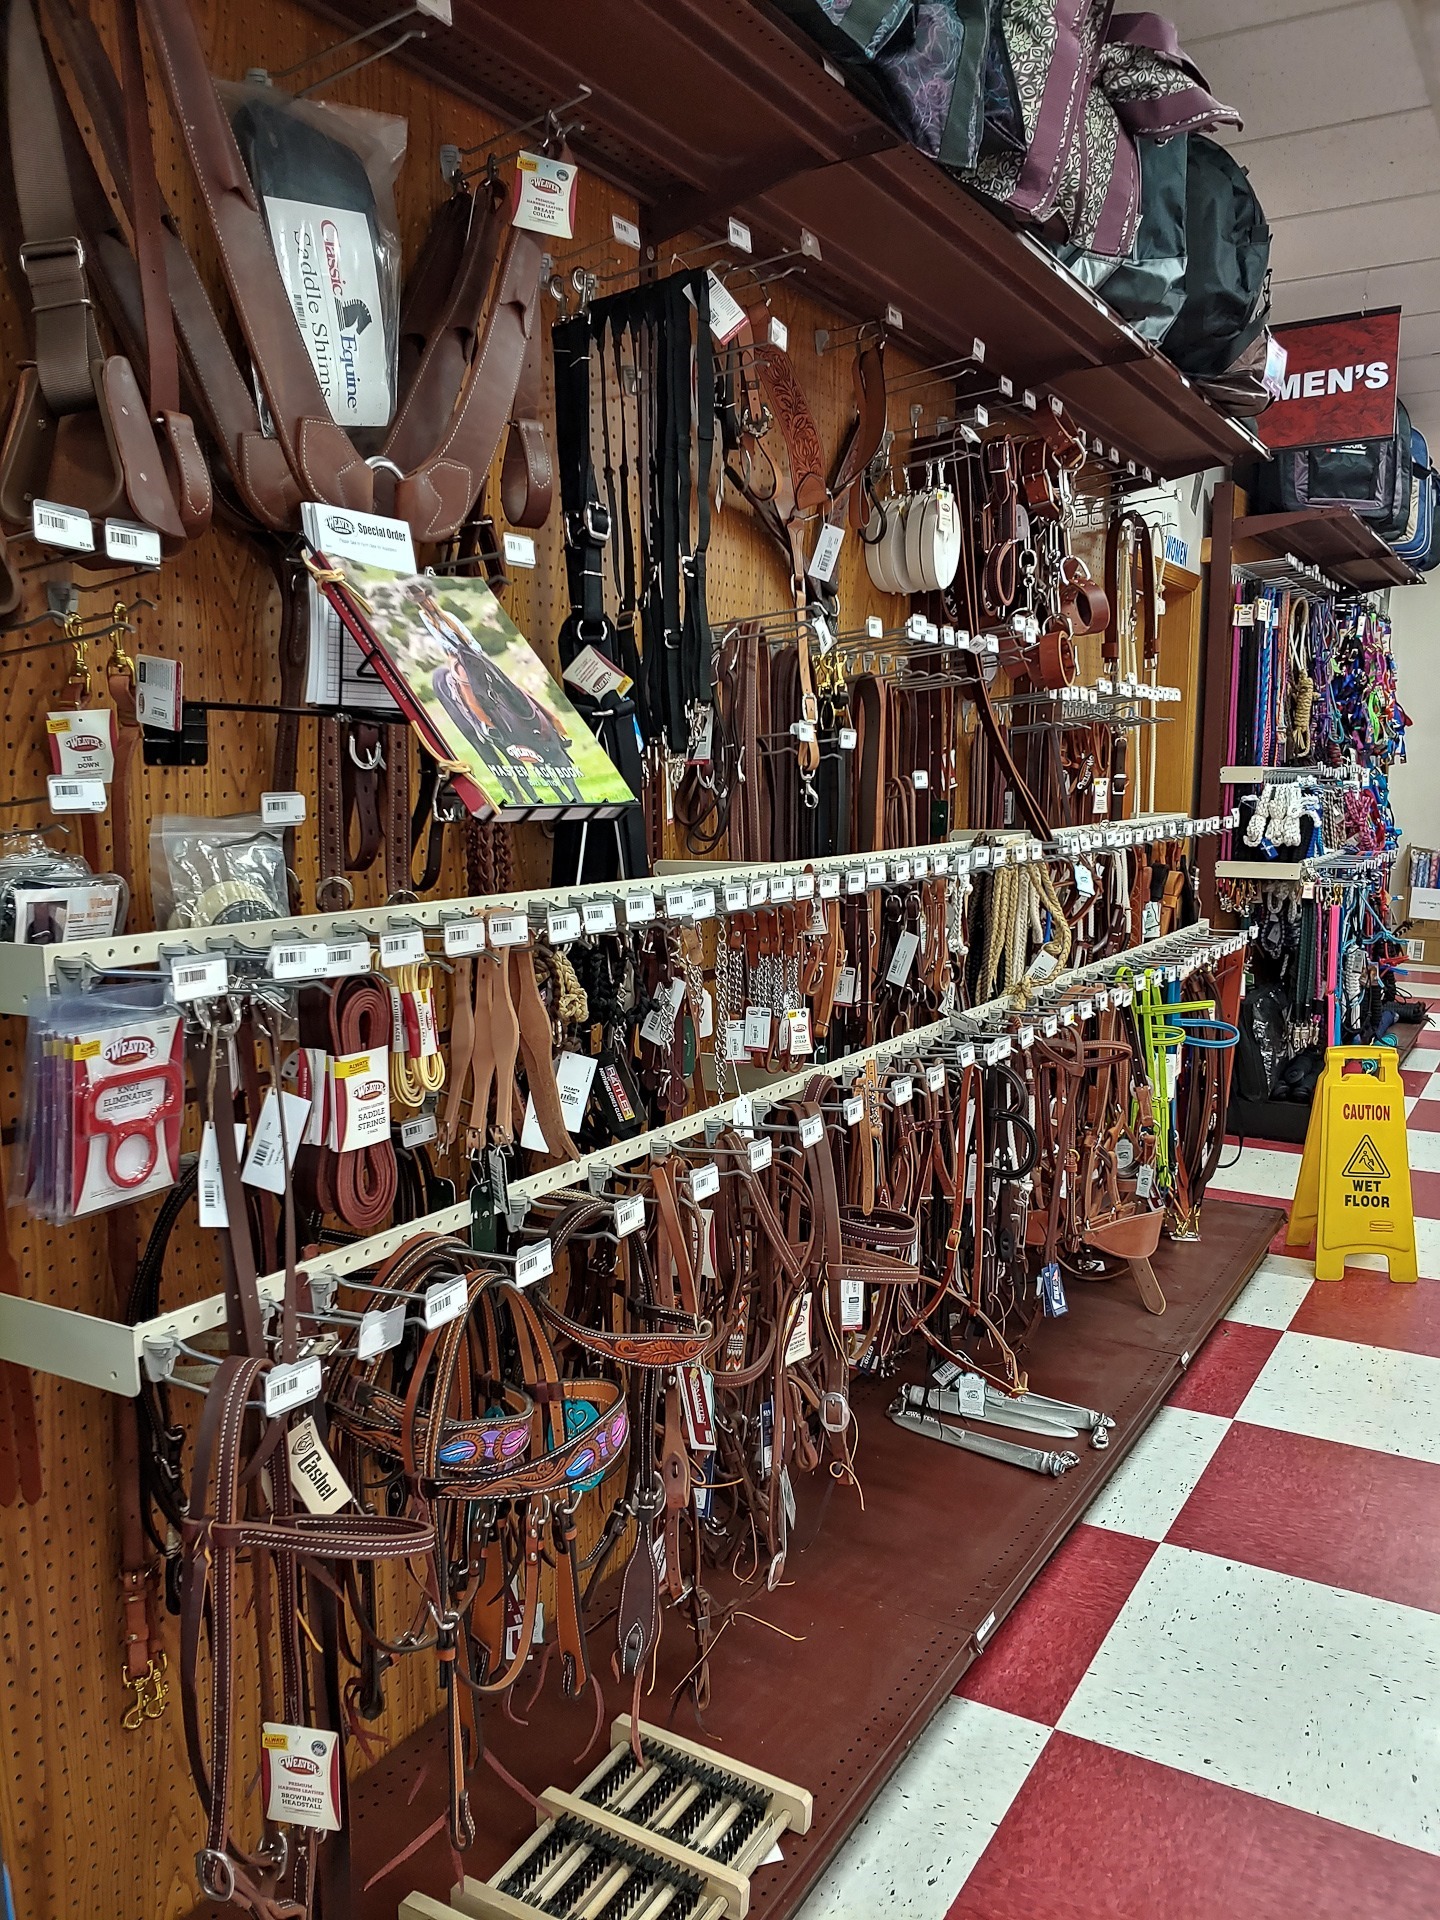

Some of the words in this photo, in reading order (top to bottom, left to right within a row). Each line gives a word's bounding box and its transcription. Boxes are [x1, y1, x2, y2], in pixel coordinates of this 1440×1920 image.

[530, 177, 564, 196] WEAVER
[293, 230, 322, 315] Saddle
[311, 321, 333, 398] Shims
[320, 218, 346, 297] Classic
[338, 333, 361, 409] Equine
[1274, 361, 1389, 402] MEN'S
[357, 522, 386, 538] Special
[386, 528, 406, 542] Order
[1165, 535, 1189, 567] WOMEN
[64, 735, 106, 750] WEAVER
[77, 761, 100, 769] DOWN
[487, 764, 529, 777] MASTER
[556, 766, 585, 778] BOOK
[103, 1036, 158, 1061] WEAVER
[349, 1060, 369, 1069] ALWAYS
[116, 1083, 141, 1094] KNOT
[353, 1082, 387, 1099] WEAVER
[598, 1067, 613, 1092] NOTHING
[608, 1091, 617, 1108] COMES
[614, 1107, 625, 1122] CLOSE
[606, 1066, 633, 1118] RATTLER
[103, 1089, 153, 1107] ELIMINATOR
[358, 1107, 385, 1121] SADDLE
[1342, 1103, 1391, 1121] CAUTION
[357, 1116, 386, 1131] STRINGS
[1352, 1180, 1382, 1193] WET
[1344, 1195, 1390, 1208] FLOOR
[696, 1388, 706, 1423] MARTIN
[297, 1449, 338, 1502] Cashel
[264, 1736, 286, 1744] ALWAYS
[278, 1755, 324, 1777] WEAVER
[288, 1780, 313, 1789] PREMIUM
[301, 1787, 325, 1796] LEATHER
[280, 1792, 323, 1804] BROWBAND
[281, 1798, 323, 1810] HEADSTALL
